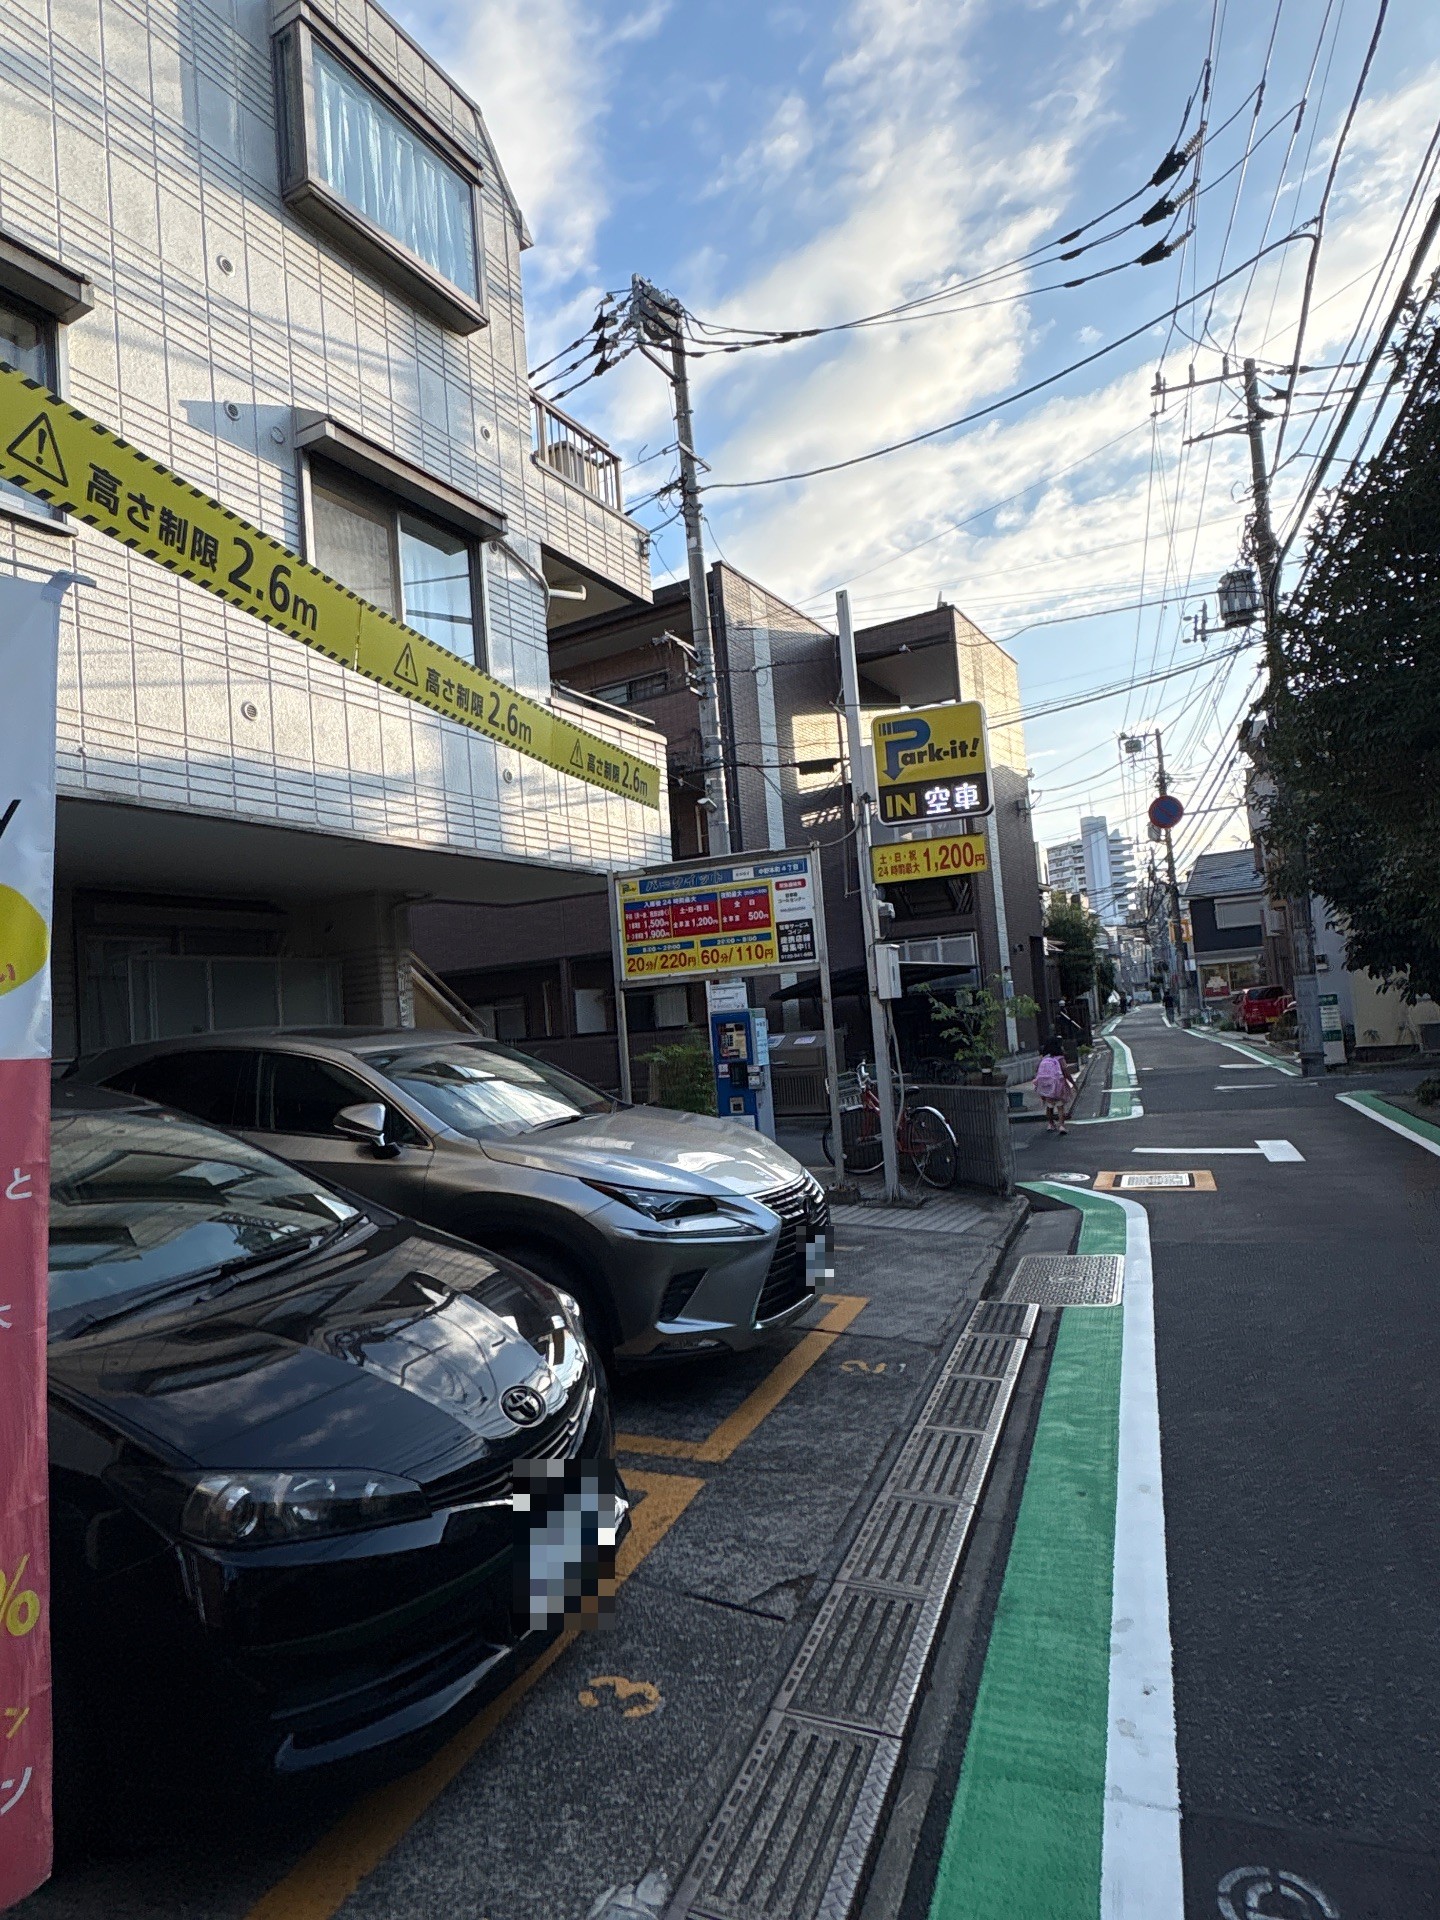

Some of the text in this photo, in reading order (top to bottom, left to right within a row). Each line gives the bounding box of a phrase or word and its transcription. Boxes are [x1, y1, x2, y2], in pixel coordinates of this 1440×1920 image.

[885, 783, 980, 819] IN 空車
[922, 842, 985, 872] 1,200円
[577, 1675, 663, 1718] 3
